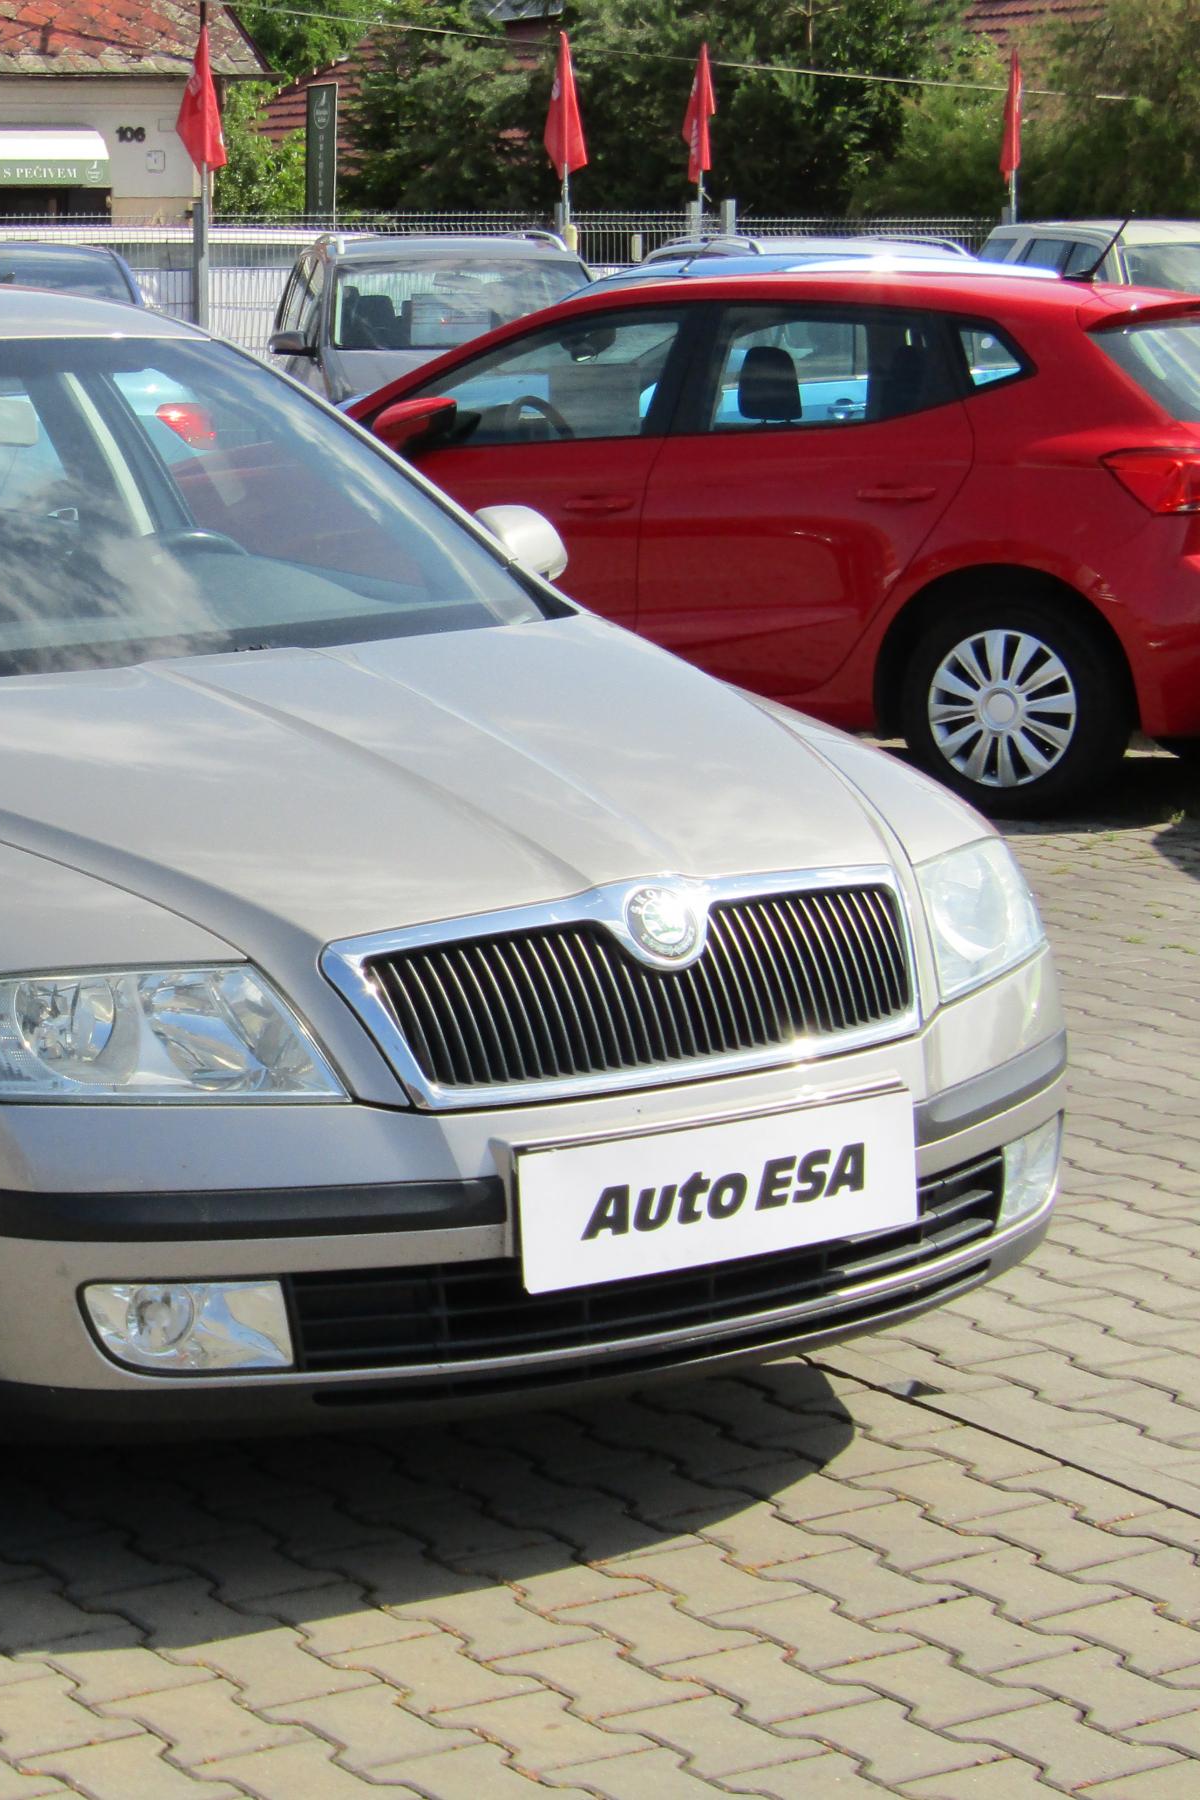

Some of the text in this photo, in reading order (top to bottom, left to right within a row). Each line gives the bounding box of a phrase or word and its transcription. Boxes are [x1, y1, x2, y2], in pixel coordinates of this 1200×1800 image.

[116, 126, 146, 143] 106
[3, 167, 11, 179] S
[16, 164, 78, 179] PEČIVEM
[580, 1142, 865, 1241] Auto ESA
